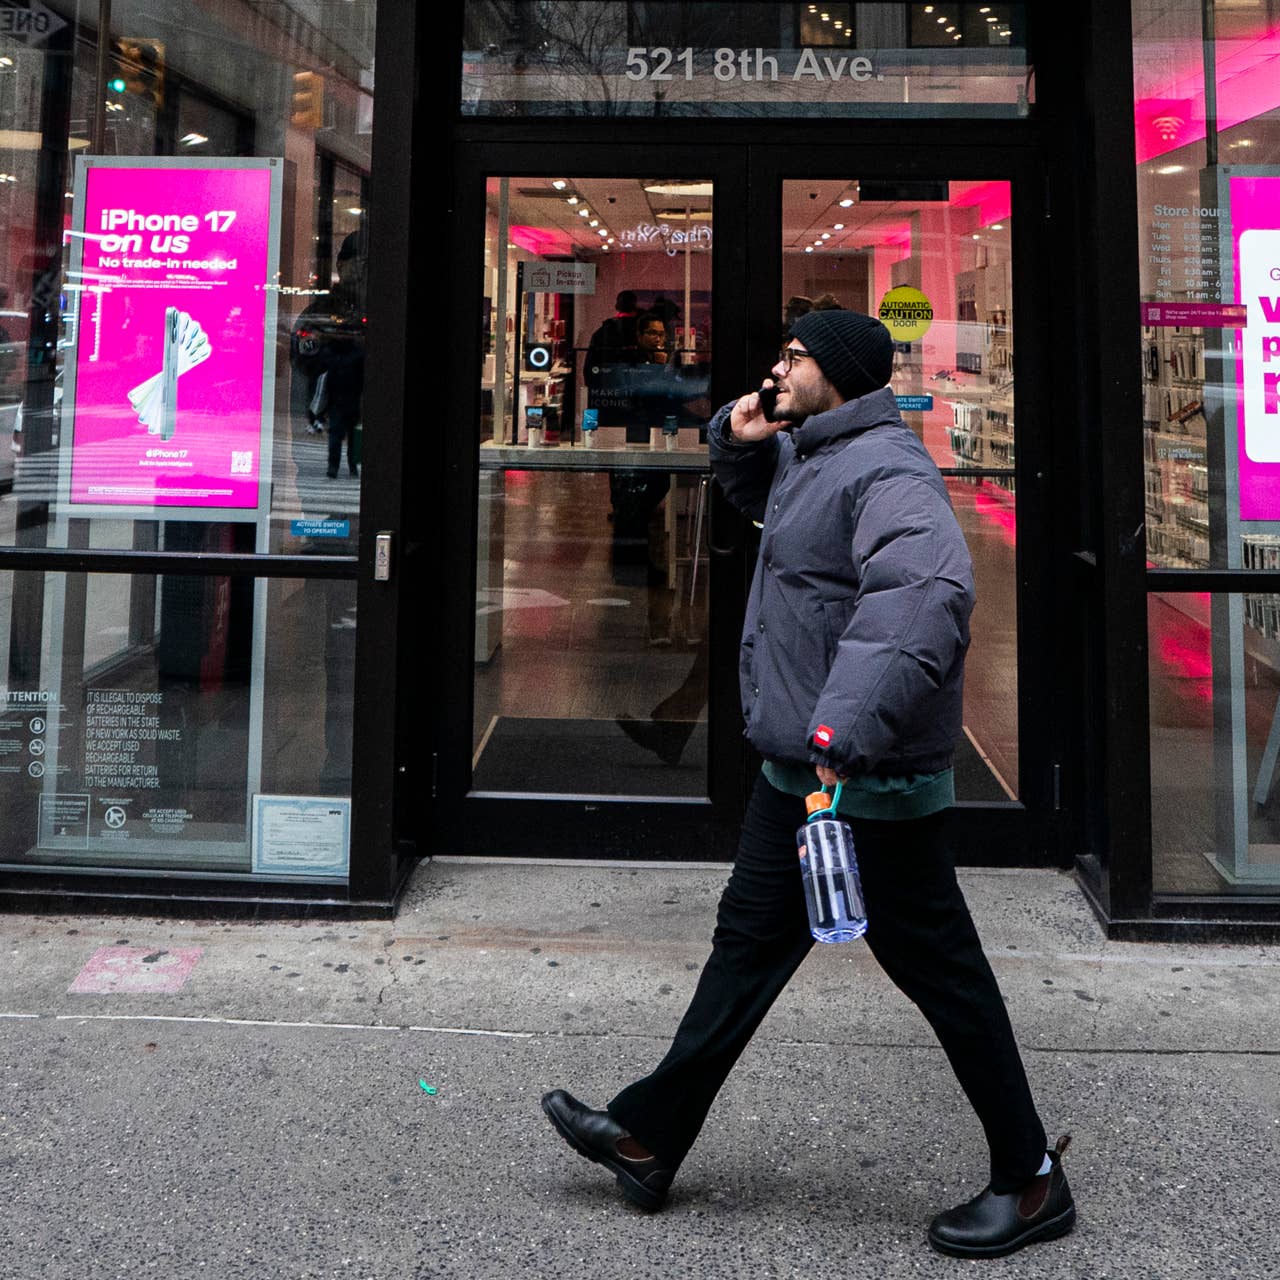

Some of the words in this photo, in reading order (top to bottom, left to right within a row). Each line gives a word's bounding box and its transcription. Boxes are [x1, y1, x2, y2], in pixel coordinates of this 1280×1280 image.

[624, 47, 694, 82] 521
[714, 47, 778, 82] 8th
[793, 47, 885, 83] Ave.
[1153, 204, 1189, 217] Store
[1192, 204, 1230, 218] hours
[100, 209, 199, 233] iPhone
[204, 209, 237, 233] 17
[99, 235, 142, 254] on
[150, 235, 190, 254] us
[98, 256, 120, 269] No
[122, 257, 180, 269] trade-in
[182, 258, 238, 270] needed
[1186, 291, 1194, 299] 11
[879, 309, 932, 321] CAUTION
[893, 320, 918, 328] DOOR
[590, 389, 621, 398] MAKE
[590, 399, 630, 408] ICONIC
[0, 691, 57, 702] ATTENTION
[87, 692, 93, 702] IT
[94, 692, 100, 702] IS
[101, 692, 125, 703] ILLEGAL
[126, 693, 134, 703] TO
[135, 693, 162, 704] DISPOSE
[87, 704, 95, 714] OF
[96, 704, 145, 715] RECHARGEABLE
[87, 716, 119, 727] BATTERIES
[120, 717, 126, 727] IN
[128, 717, 140, 727] THE
[141, 717, 160, 728] STATE
[86, 728, 95, 738] OF
[96, 729, 110, 738] NEW
[111, 729, 128, 739] YORK
[129, 729, 138, 739] AS
[139, 729, 157, 740] SOLID
[86, 740, 96, 750] WE
[97, 740, 122, 751] ACCEPT
[123, 741, 140, 751] USED
[85, 752, 135, 763] RECHARGEABLE
[85, 764, 118, 775] BATTERIES
[119, 765, 131, 775] FOR
[132, 765, 158, 776] RETURN
[84, 777, 93, 786] TO
[94, 777, 106, 787] THE
